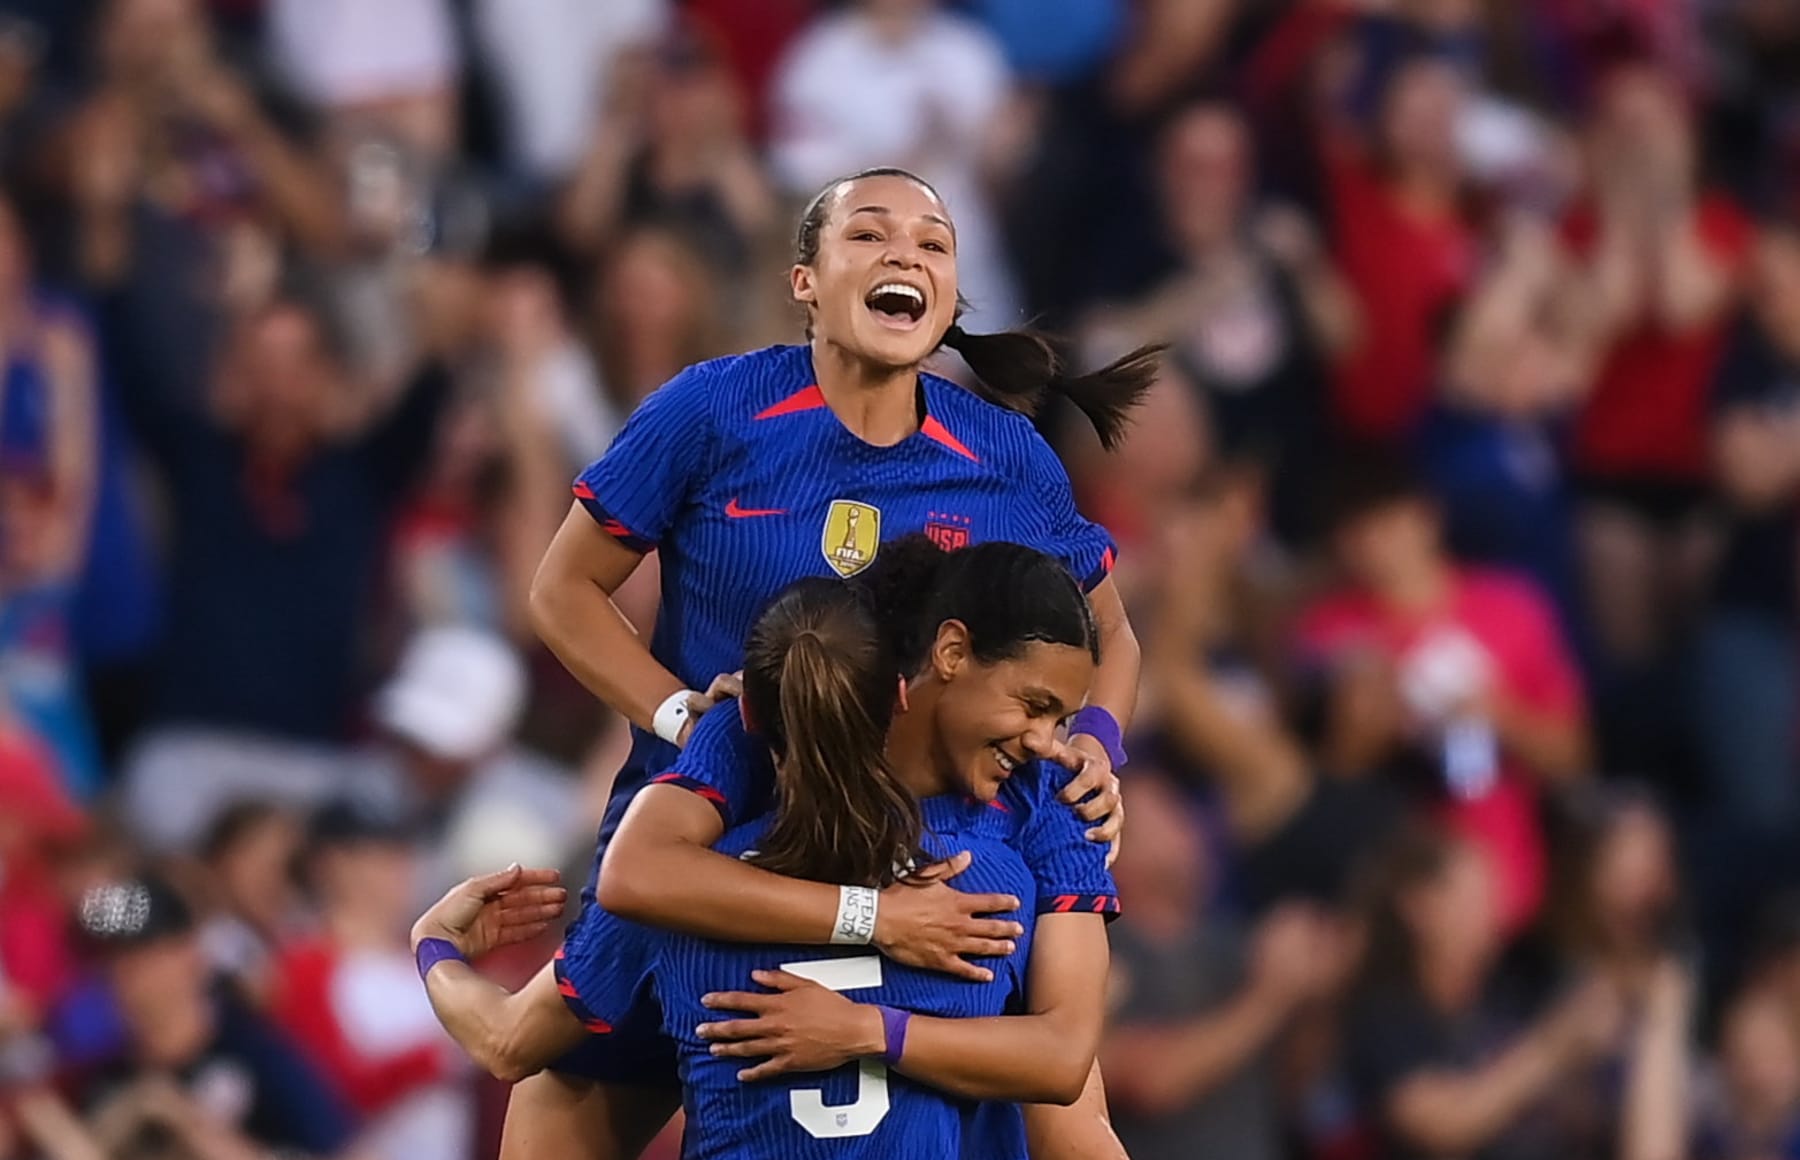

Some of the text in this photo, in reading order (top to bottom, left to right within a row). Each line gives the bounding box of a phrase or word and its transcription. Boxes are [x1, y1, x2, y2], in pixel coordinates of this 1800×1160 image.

[835, 547, 861, 560] FIFA
[840, 911, 858, 938] JOY
[779, 955, 890, 1139] 5
